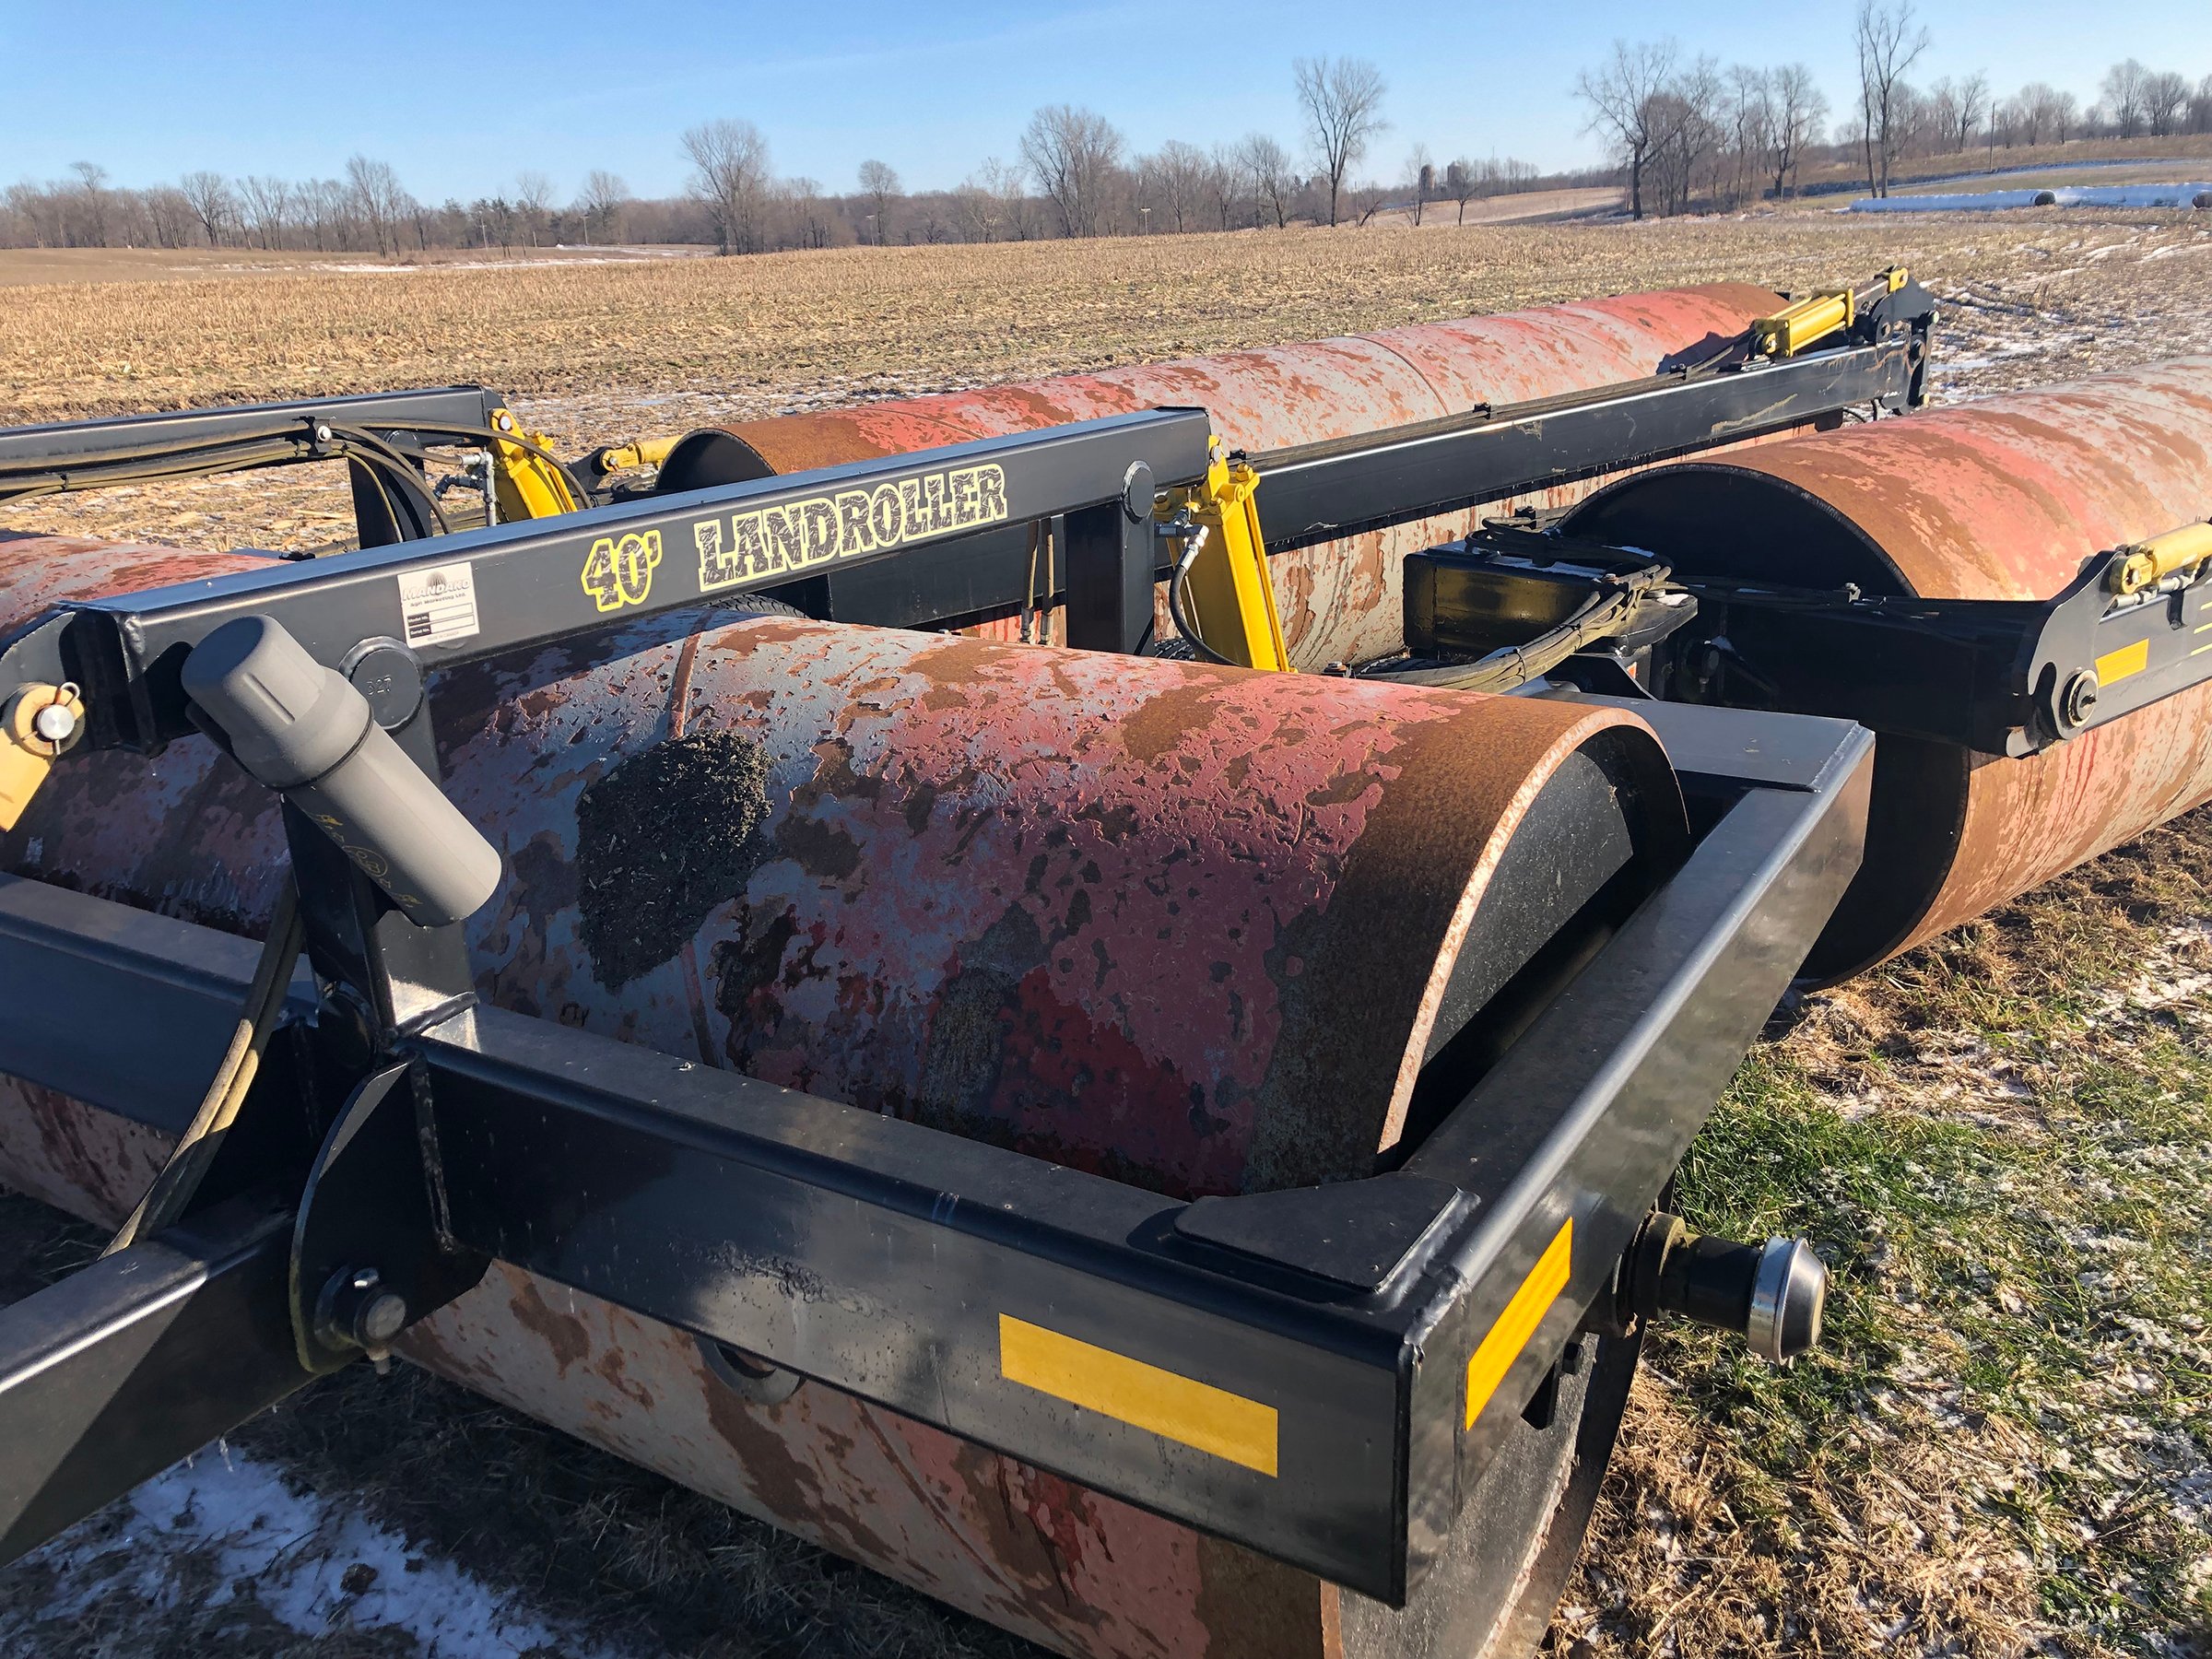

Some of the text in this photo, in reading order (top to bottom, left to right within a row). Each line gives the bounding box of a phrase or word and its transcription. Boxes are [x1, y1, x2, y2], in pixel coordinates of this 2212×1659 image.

[581, 463, 1008, 613] 40' LANDROLLER
[402, 580, 470, 601] MANDAKO
[424, 594, 454, 605] Marketing
